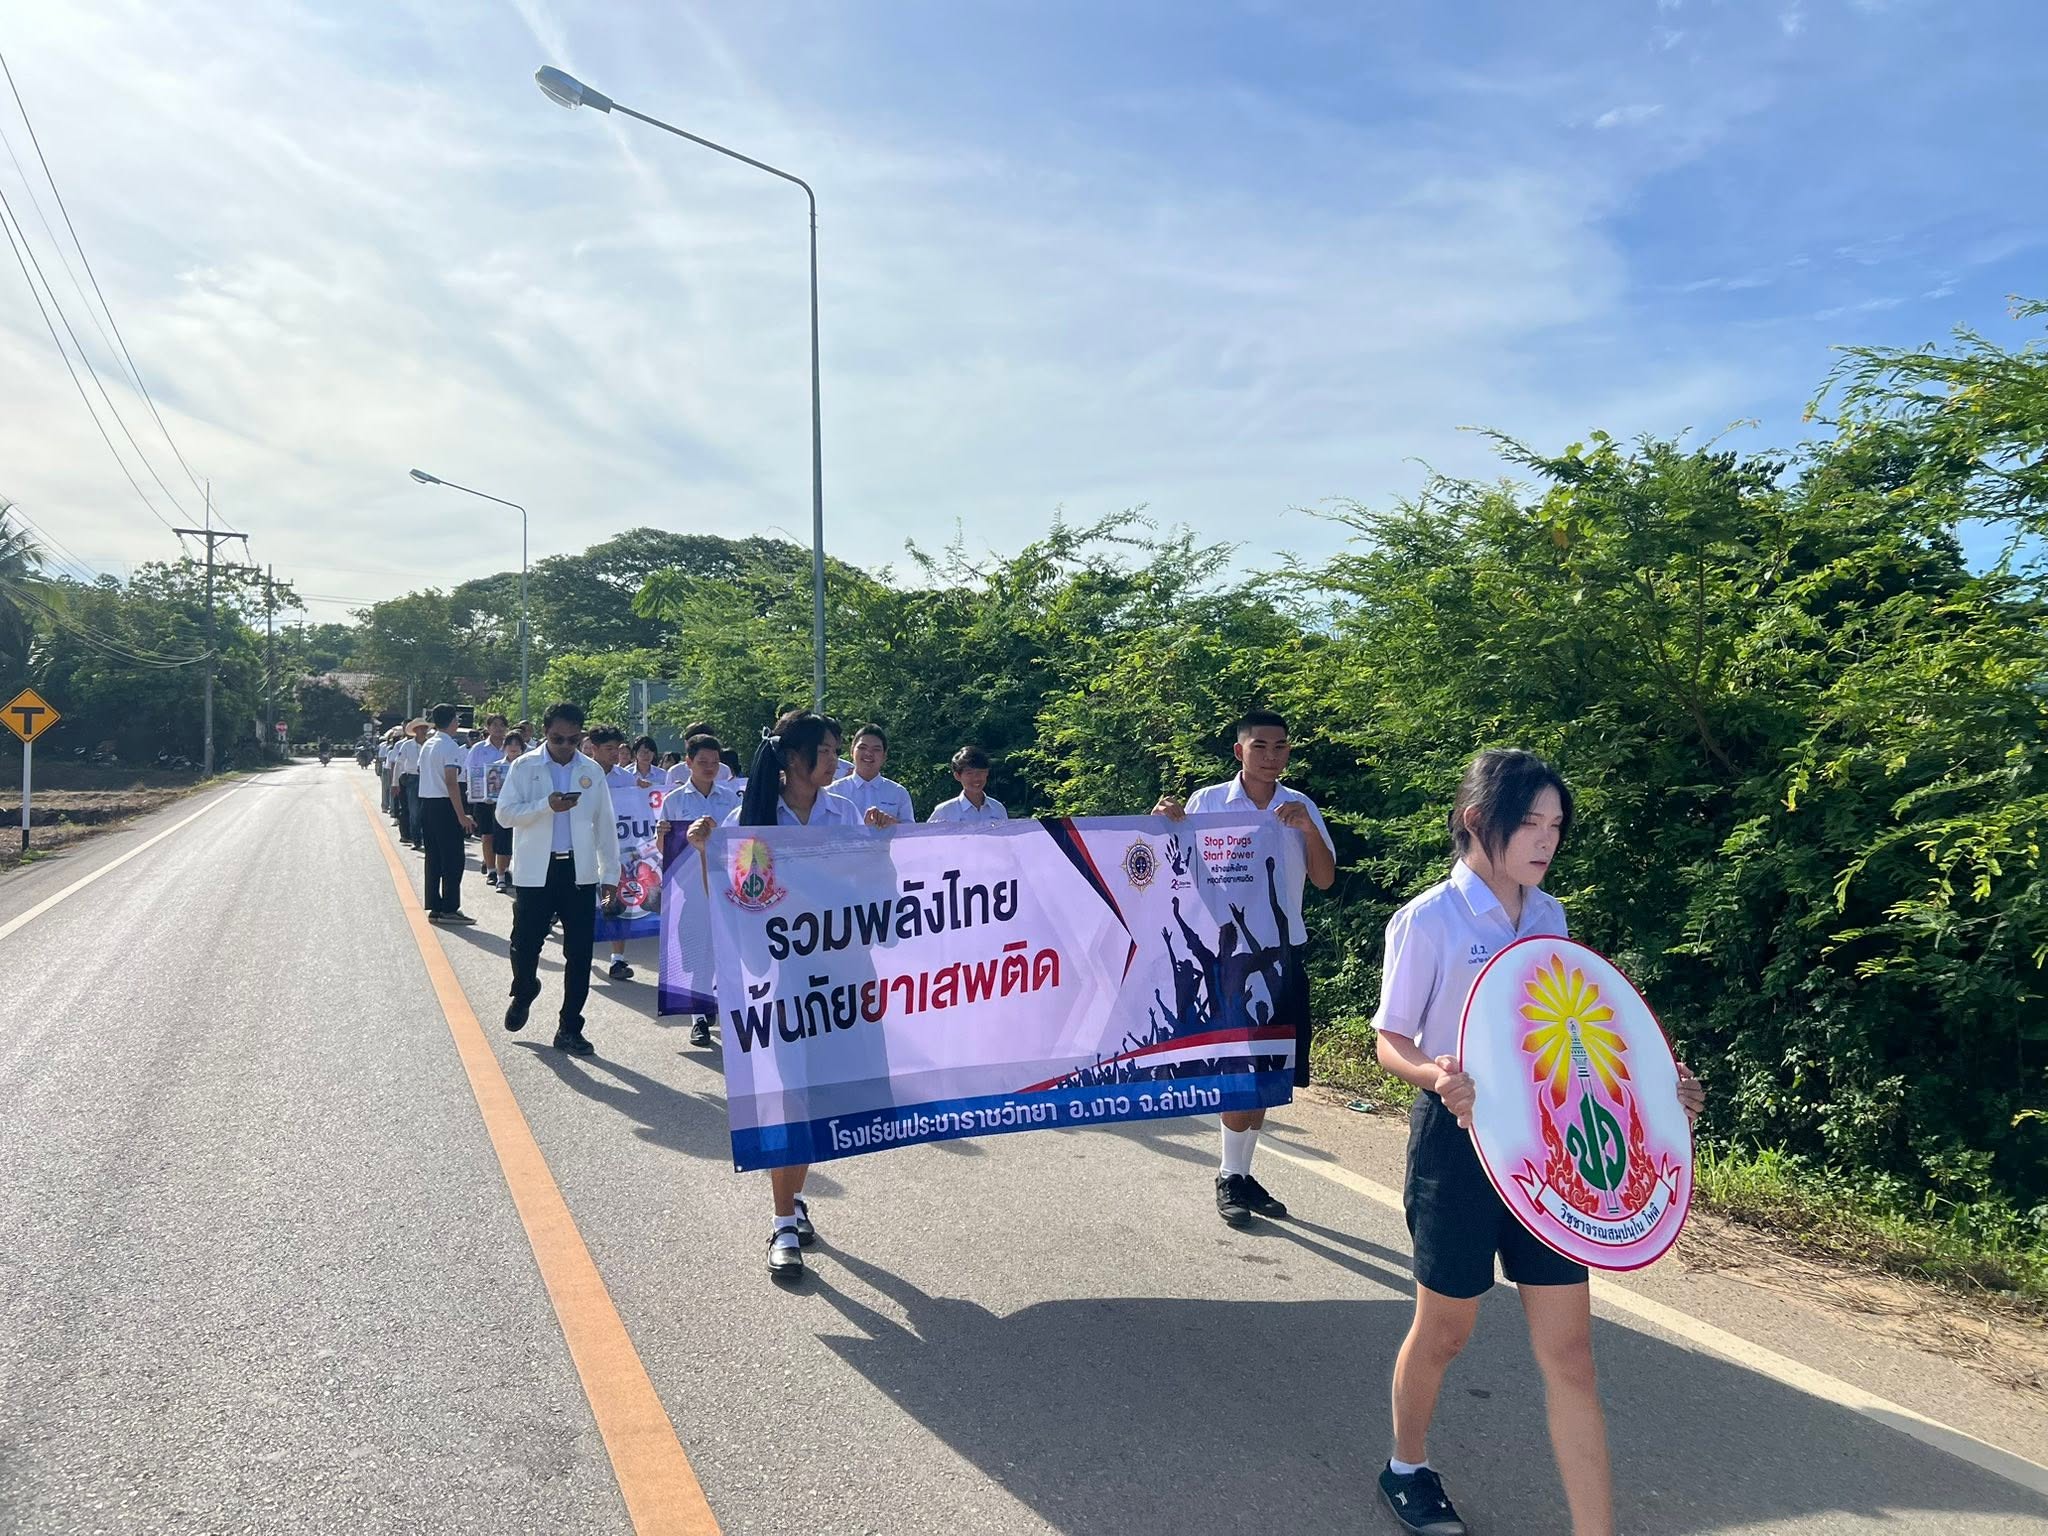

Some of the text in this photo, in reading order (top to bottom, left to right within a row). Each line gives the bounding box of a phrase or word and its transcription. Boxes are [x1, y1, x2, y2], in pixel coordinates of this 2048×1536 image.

[1203, 849, 1255, 861] Start Power
[1204, 835, 1252, 849] Stop Drugs
[765, 869, 1019, 961] รวมพลังไทย
[730, 940, 1061, 1054] พ้นภัยยาเสพติด
[828, 1084, 1222, 1151] โรงเรียนประชาราชวิทยา อ.งาว จ.ลำปาง
